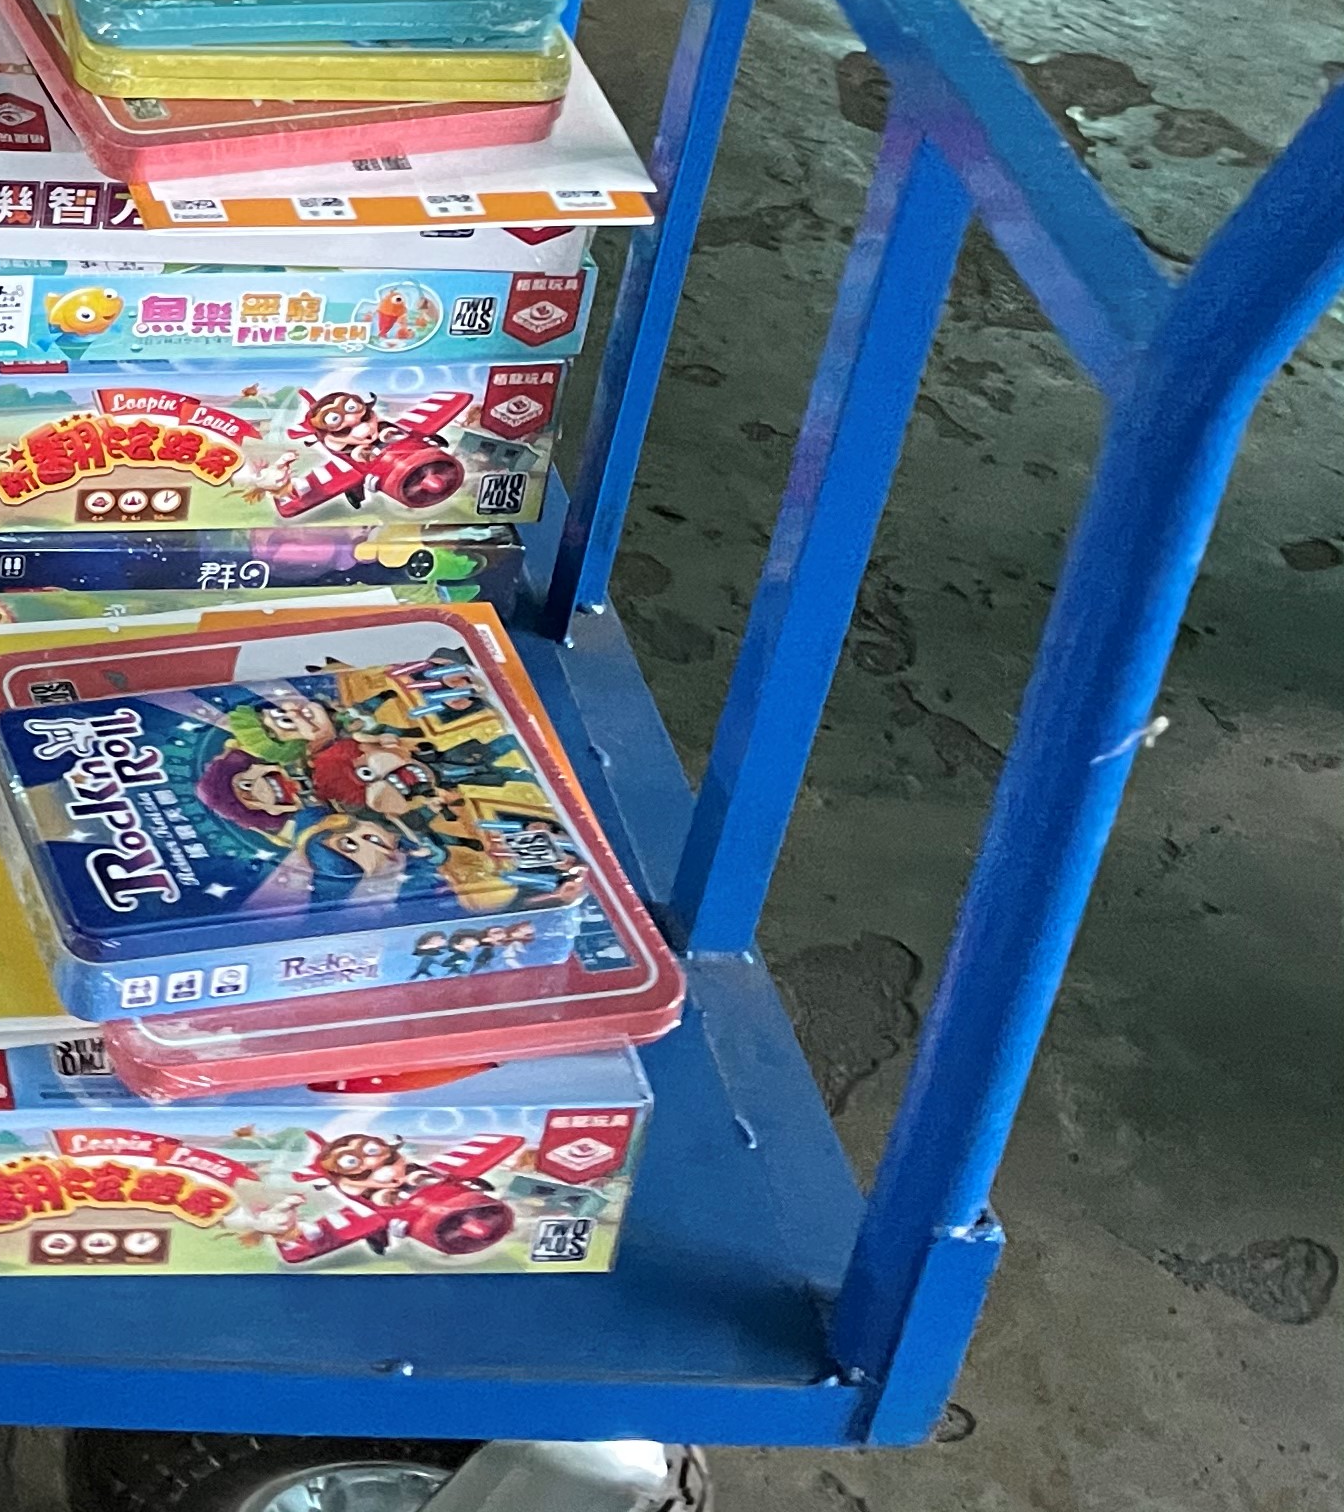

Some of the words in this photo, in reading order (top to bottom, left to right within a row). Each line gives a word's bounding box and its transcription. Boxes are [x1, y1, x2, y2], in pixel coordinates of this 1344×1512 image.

[453, 310, 493, 335] PLUS
[111, 392, 187, 413] Loopin'
[188, 405, 241, 437] Louie
[90, 707, 170, 786] Roll
